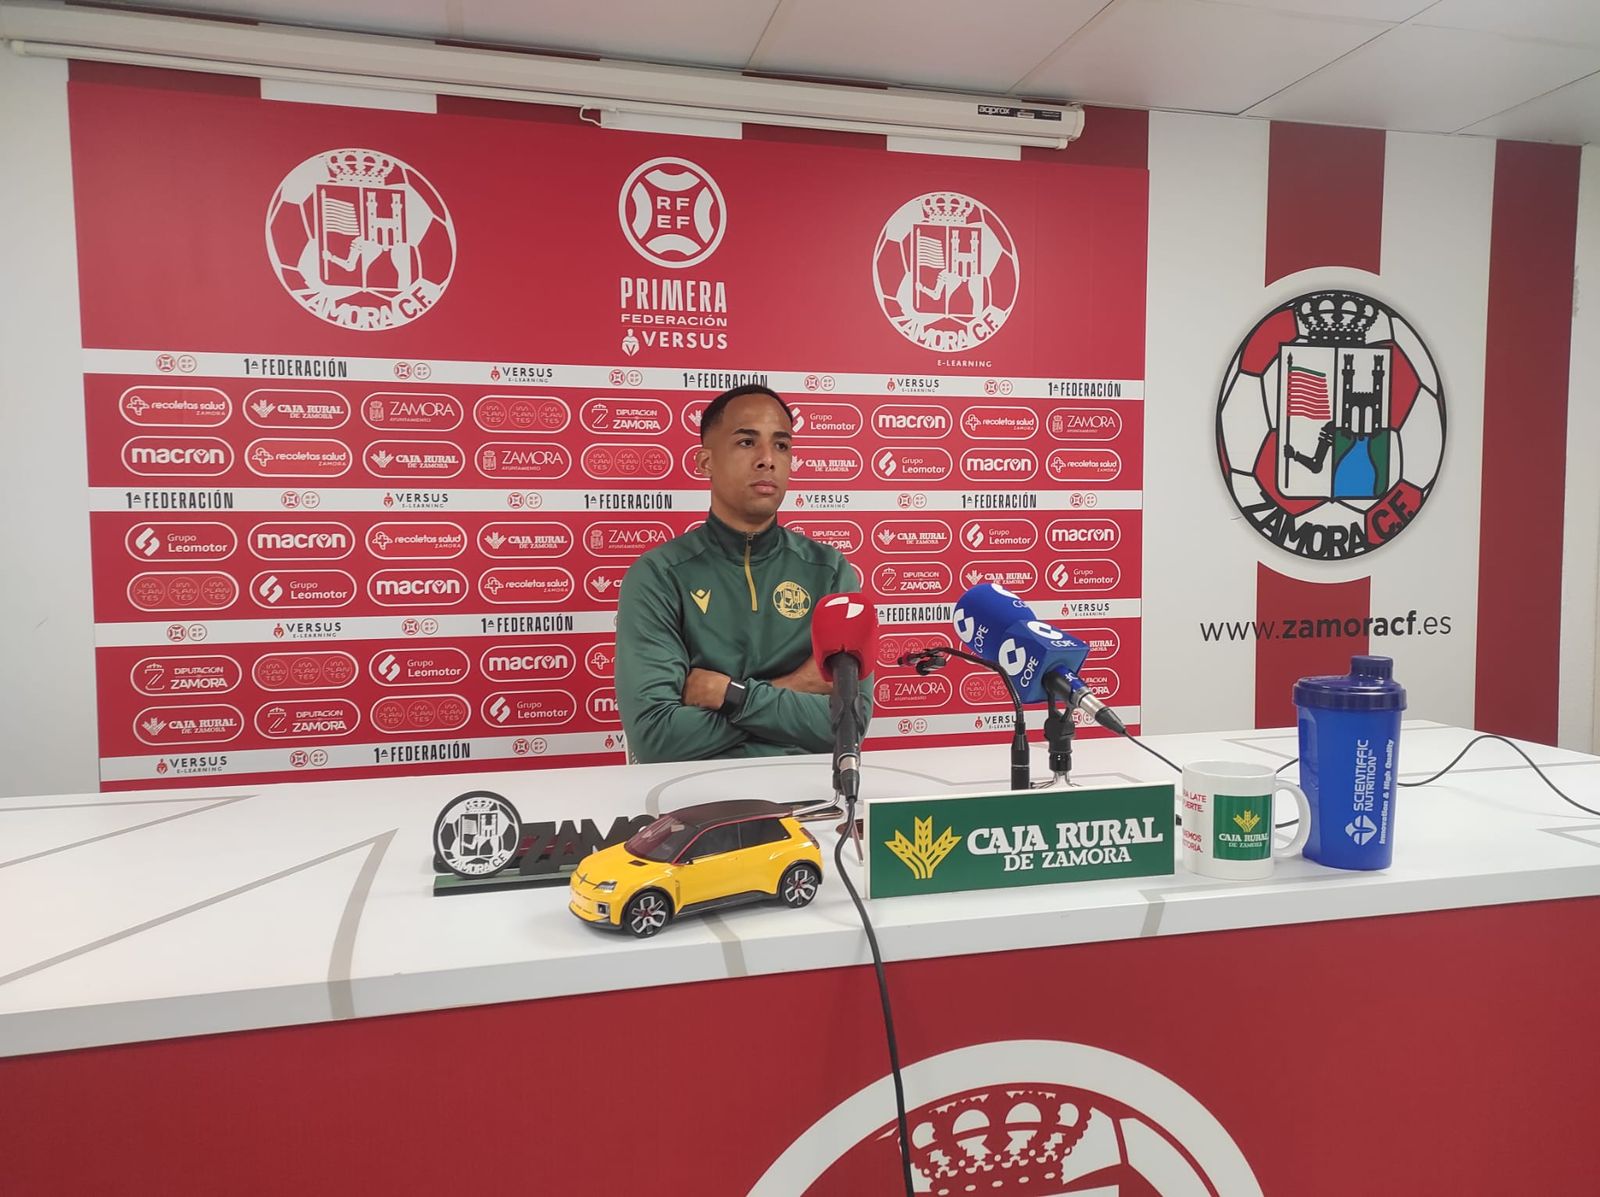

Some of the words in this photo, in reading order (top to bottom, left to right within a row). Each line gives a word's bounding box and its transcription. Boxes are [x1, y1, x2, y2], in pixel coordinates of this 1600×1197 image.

[620, 277, 727, 313] PRIMERA
[292, 290, 394, 329] ZAMORA
[621, 314, 727, 326] FEDERACIÓN
[891, 317, 968, 350] ZAMORA
[642, 330, 728, 350] VERSUS
[262, 359, 347, 378] FEDERACIÓN
[502, 367, 553, 378] VERSUS
[897, 379, 939, 388] VERSUS
[1061, 381, 1121, 397] FEDERACIÓN
[151, 401, 197, 410] recoletas
[199, 401, 225, 411] salud
[278, 405, 304, 413] CAJA
[306, 406, 344, 415] RURAL
[390, 401, 454, 417] ZAMORA
[810, 413, 832, 421] Grupo
[878, 414, 946, 429] macron
[983, 418, 1015, 426] recoletas
[1016, 417, 1034, 426] salud
[1067, 415, 1115, 429] ZAMORA
[613, 419, 661, 430] ZAMORA
[811, 422, 856, 430] Leomotor
[131, 448, 224, 464] macron
[275, 452, 320, 461] recoletas
[322, 452, 346, 461] salud
[396, 455, 421, 464] CAJA
[423, 455, 458, 464] RURAL
[502, 450, 563, 465] ZAMORA
[902, 457, 923, 465] Grupo
[828, 460, 857, 468] RURAL
[902, 465, 945, 474] Leomotor
[967, 457, 1031, 472] macron
[1100, 460, 1117, 468] salud
[145, 490, 233, 509] FEDERACIÓN
[396, 493, 448, 503] VERSUS
[600, 492, 672, 510] FEDERACIÓN
[805, 495, 850, 503] VERSUS
[974, 493, 1036, 508] FEDERACIÓN
[608, 529, 666, 544] ZAMORA
[919, 532, 947, 540] RURAL
[989, 528, 1009, 536] Grupo
[1052, 529, 1114, 542] macron
[1242, 504, 1368, 558] ZAMORA
[167, 534, 196, 543] Grupo
[257, 533, 346, 549] macron
[394, 535, 436, 543] recoletas
[438, 534, 461, 543] salud
[508, 536, 532, 544] CAJA
[535, 536, 567, 544] RURAL
[989, 537, 1031, 545] Leomotor
[168, 543, 227, 552] Leomotor
[985, 573, 1004, 581] CAJA
[1006, 572, 1032, 580] RURAL
[290, 581, 318, 590] Grupo
[376, 580, 460, 595] macron
[505, 580, 545, 588] recoletas
[546, 578, 568, 588] salud
[901, 582, 942, 590] ZAMORA
[291, 589, 348, 600] Leomotor
[1071, 603, 1109, 612] VERSUS
[887, 605, 950, 622] FEDERACIÓN
[286, 622, 341, 633] VERSUS
[497, 615, 573, 633] FEDERACIÓN
[1200, 610, 1451, 642] www.zamoracf.es
[407, 659, 433, 667] Grupo
[489, 655, 568, 671] macron
[408, 667, 461, 677] Leomotor
[1021, 656, 1039, 687] COPE
[170, 678, 228, 689] ZAMORA
[894, 682, 946, 695] ZAMORA
[517, 701, 542, 709] Grupo
[517, 708, 568, 718] Leomotor
[169, 720, 196, 729] CAJA
[199, 718, 237, 728] RURAL
[292, 720, 347, 732] ZAMORA
[984, 716, 1017, 726] VERSU
[391, 743, 470, 762] FEDERACIÓN
[1385, 739, 1394, 769] Quality
[170, 756, 227, 768] VERSUS
[1383, 791, 1389, 799] &
[1379, 800, 1388, 844] Innovation
[967, 825, 1048, 856] CAJA
[1055, 816, 1163, 850] RURAL
[1219, 833, 1242, 842] CAJA
[1245, 833, 1269, 841] RURAL
[1003, 853, 1033, 871] DE
[1042, 847, 1132, 869] ZAMORA
